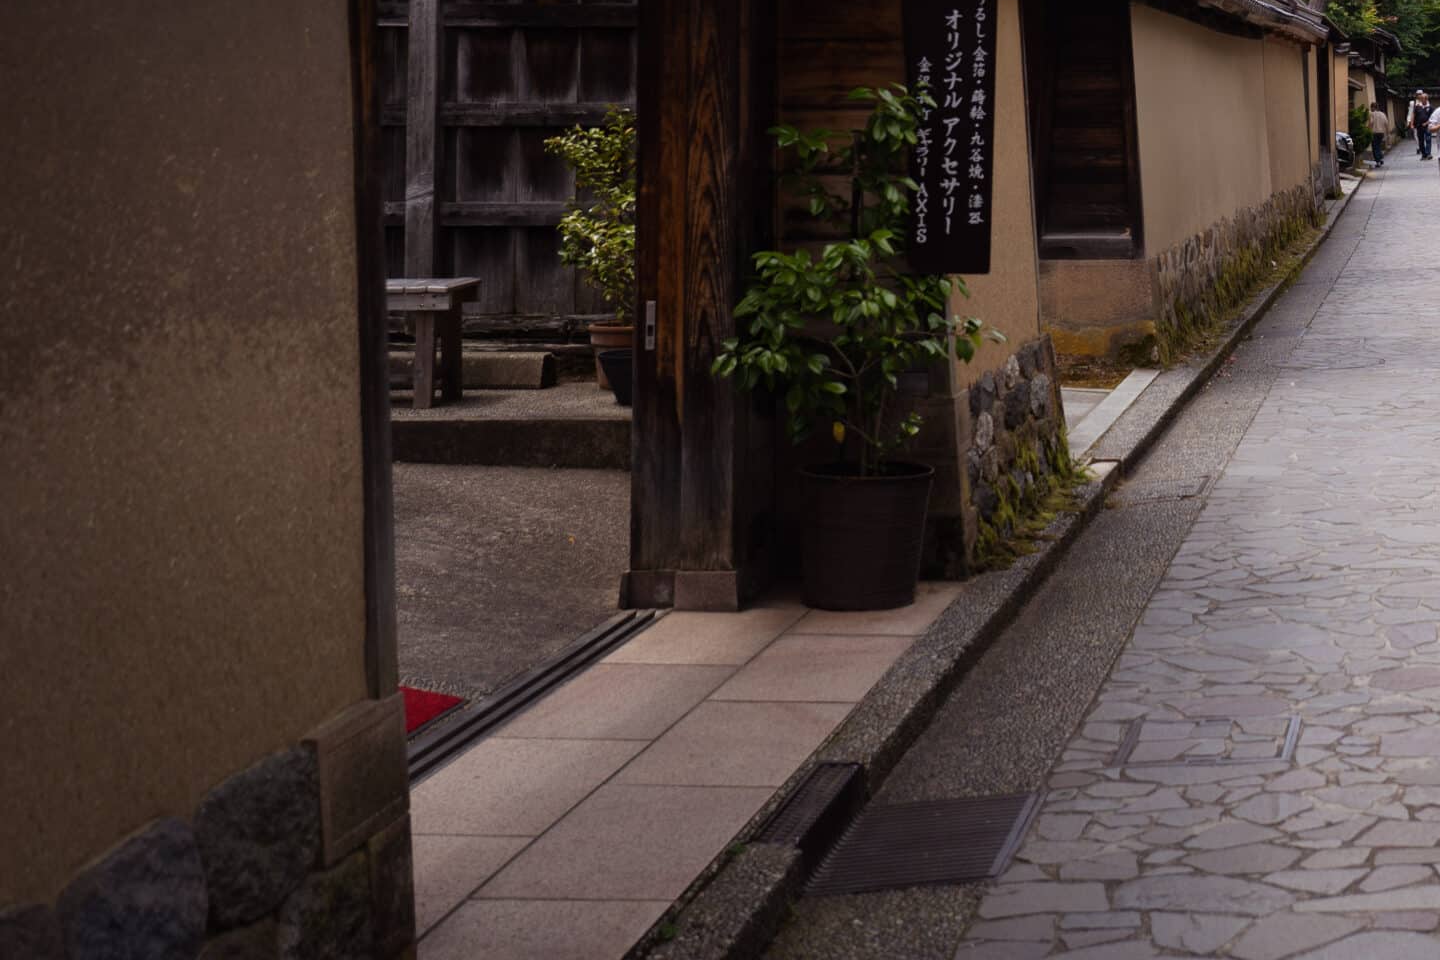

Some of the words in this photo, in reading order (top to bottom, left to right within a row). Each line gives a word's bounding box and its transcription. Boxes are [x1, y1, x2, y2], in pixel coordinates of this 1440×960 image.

[943, 9, 963, 108] オリジナル
[915, 182, 928, 243] AXIS
[939, 117, 961, 235] アクセサリー
